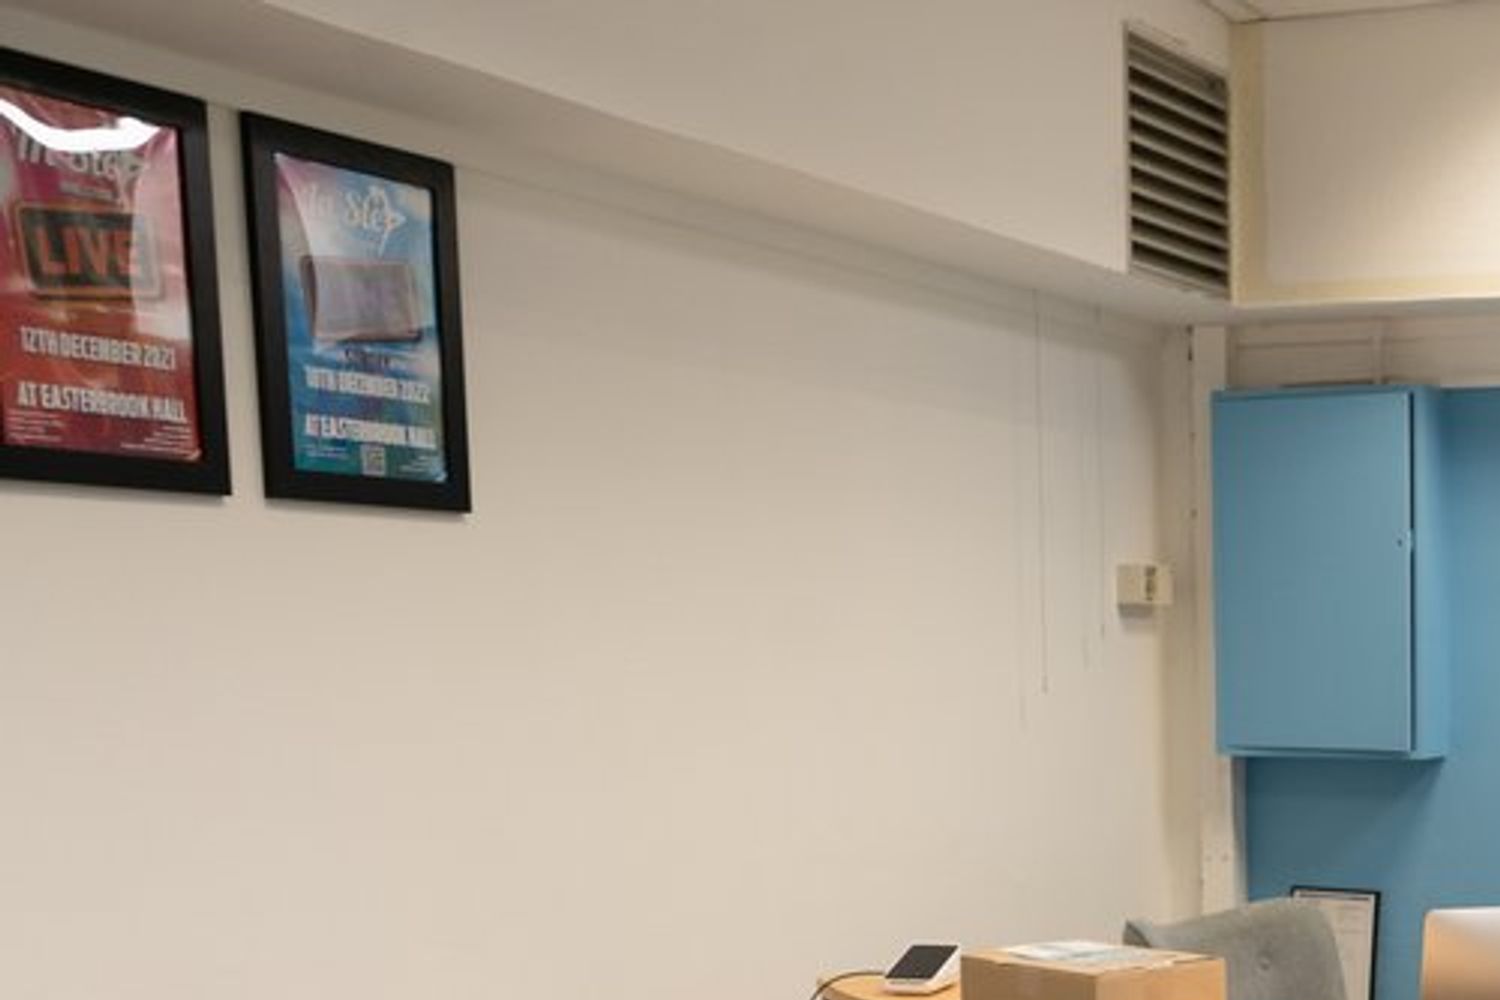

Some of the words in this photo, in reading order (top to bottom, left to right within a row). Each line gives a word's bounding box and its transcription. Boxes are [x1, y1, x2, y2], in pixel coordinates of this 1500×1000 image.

[36, 226, 142, 276] LIVE
[21, 325, 58, 356] 12TH
[59, 332, 143, 367] DECEMBER
[143, 344, 177, 372] 2021
[18, 380, 37, 407] AT
[152, 397, 188, 424] HALL
